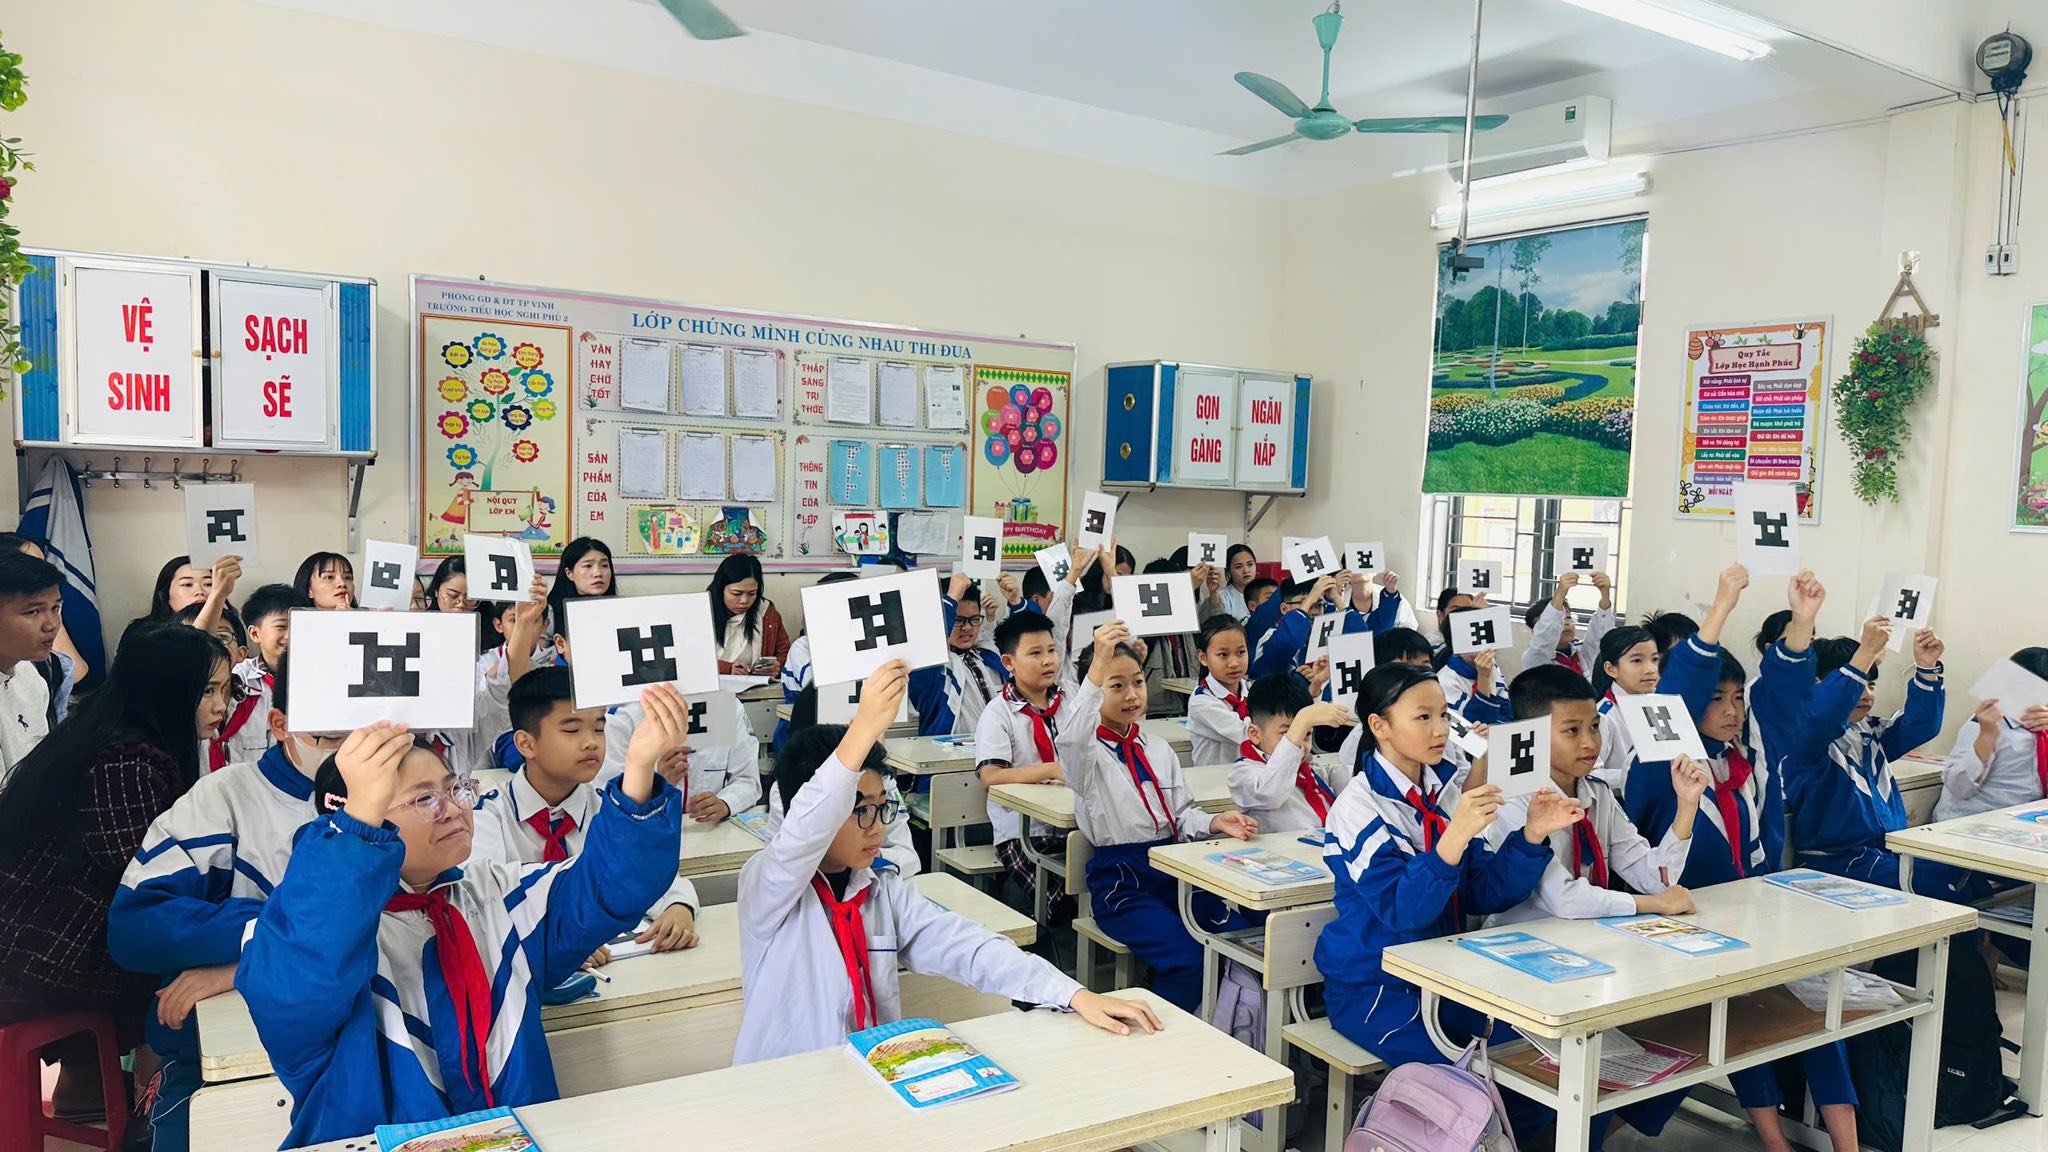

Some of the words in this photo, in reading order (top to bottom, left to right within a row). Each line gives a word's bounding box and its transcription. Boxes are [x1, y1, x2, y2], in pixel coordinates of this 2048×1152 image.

[477, 295, 491, 303] GD
[531, 301, 555, 310] VINH
[516, 311, 540, 320] NGHI
[122, 297, 153, 352] VỆ
[245, 314, 308, 361] SẠCH
[632, 310, 672, 330] LỚP
[678, 317, 746, 338] CHÚNG
[751, 323, 800, 343] MÌNH
[805, 328, 853, 348] CÙNG
[858, 336, 904, 353] NHAU
[908, 341, 936, 356] THI
[940, 344, 972, 359] ĐUA
[1738, 350, 1754, 359] Quy
[590, 359, 612, 369] HAY
[1715, 362, 1730, 370] Lớp
[1732, 361, 1747, 370] Học
[1749, 360, 1770, 369] Hạnh
[1772, 358, 1793, 367] Phúc
[108, 372, 170, 412] SINH
[263, 375, 292, 418] SẼ
[591, 387, 611, 399] TỐT
[1196, 394, 1220, 425] GỌN
[1251, 396, 1282, 425] NGĂN
[1191, 433, 1222, 463] GÀNG
[1253, 434, 1276, 466] NẮP
[587, 450, 608, 464] SẢN
[799, 460, 823, 472] THÔNG
[583, 468, 612, 483] PHẨM
[804, 480, 818, 490] TIN
[487, 496, 500, 505] NỘI
[502, 497, 518, 505] QUY
[587, 489, 607, 502] CỦA
[590, 511, 604, 521] EM
[802, 513, 818, 524] LỚP
[1014, 526, 1047, 535] BIRTHDAY
